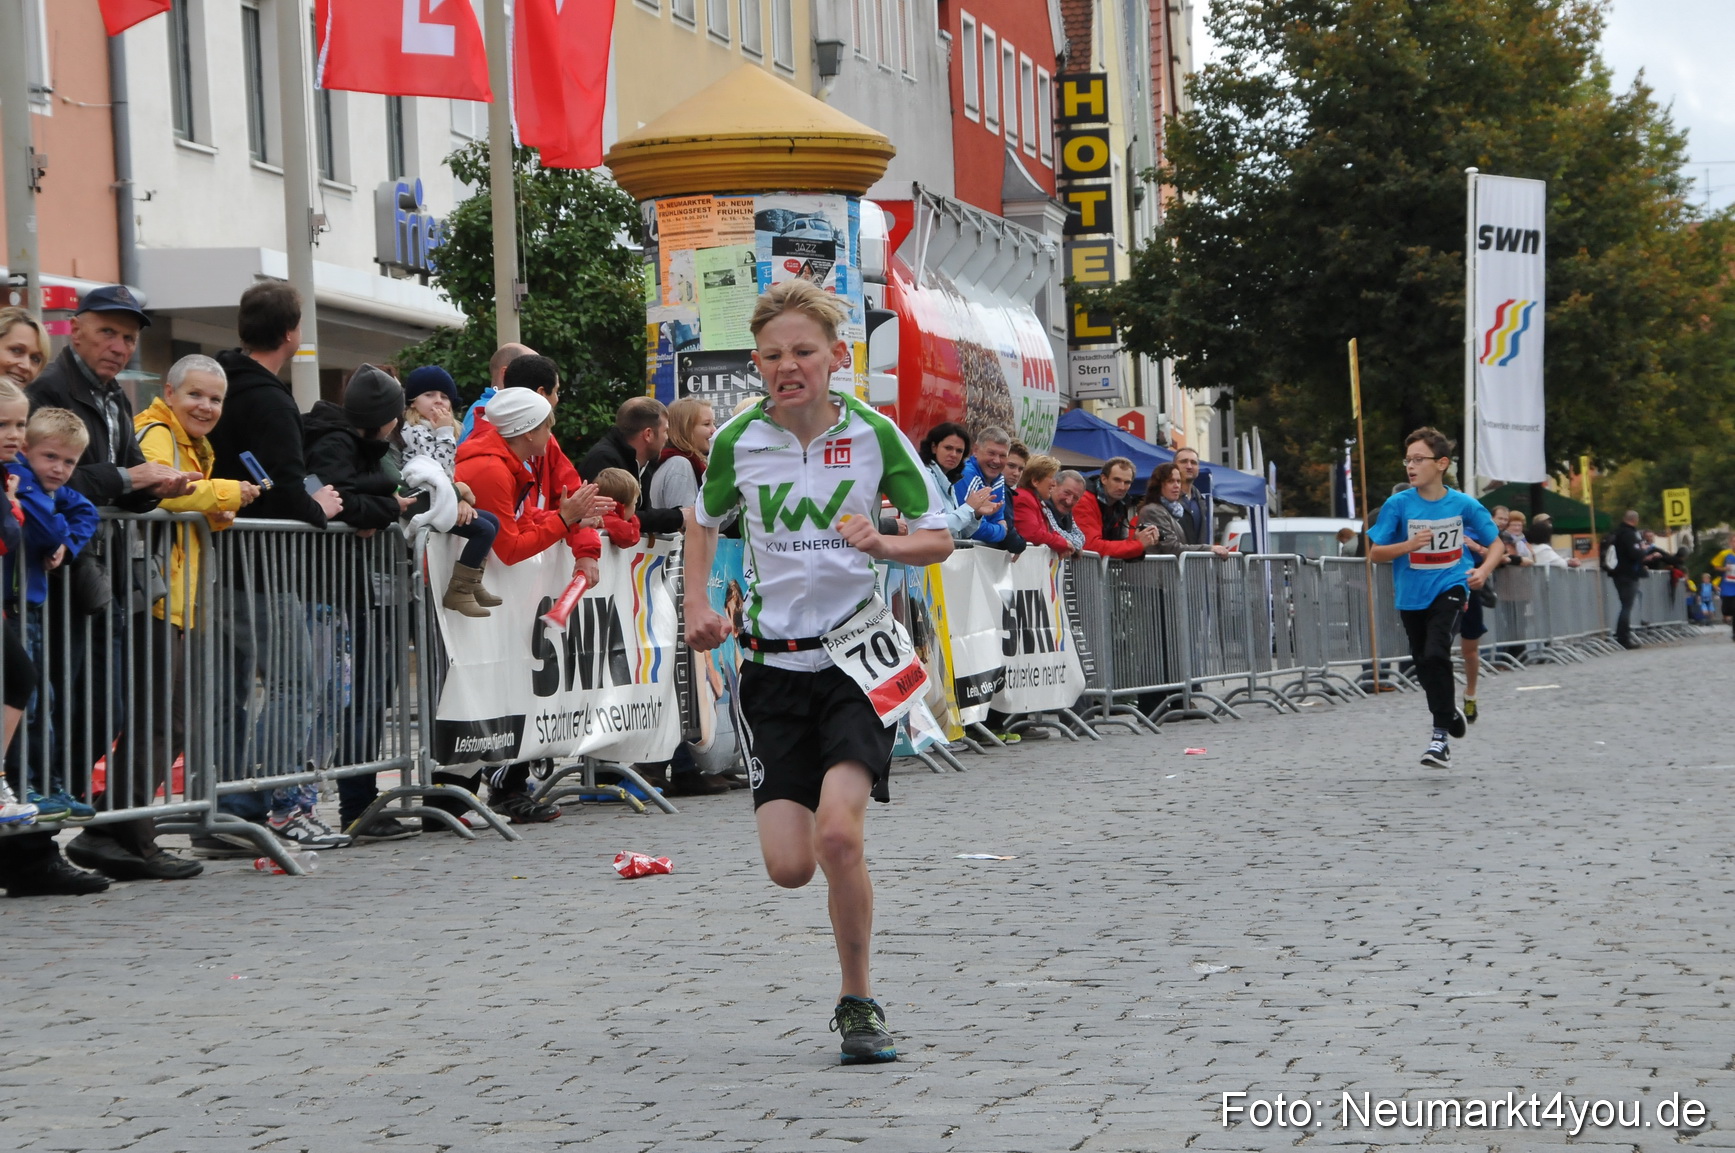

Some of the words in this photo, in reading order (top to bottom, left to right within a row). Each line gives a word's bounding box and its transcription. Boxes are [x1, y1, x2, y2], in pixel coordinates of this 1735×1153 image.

[658, 206, 712, 218] FRÜHLINGSFEST
[666, 198, 712, 209] NEUMARKTER
[1063, 79, 1112, 337] HOTEL
[794, 242, 817, 253] JAZZ
[1478, 224, 1540, 254] swn
[1016, 331, 1057, 393] AVIA
[1078, 364, 1111, 375] Stern
[687, 373, 763, 393] GLENN
[1020, 396, 1054, 450] Pellets
[1672, 500, 1684, 517] D
[765, 541, 788, 552] KW
[826, 629, 865, 653] PARTL
[895, 666, 924, 696] Niklas
[595, 695, 663, 733] neumarkt
